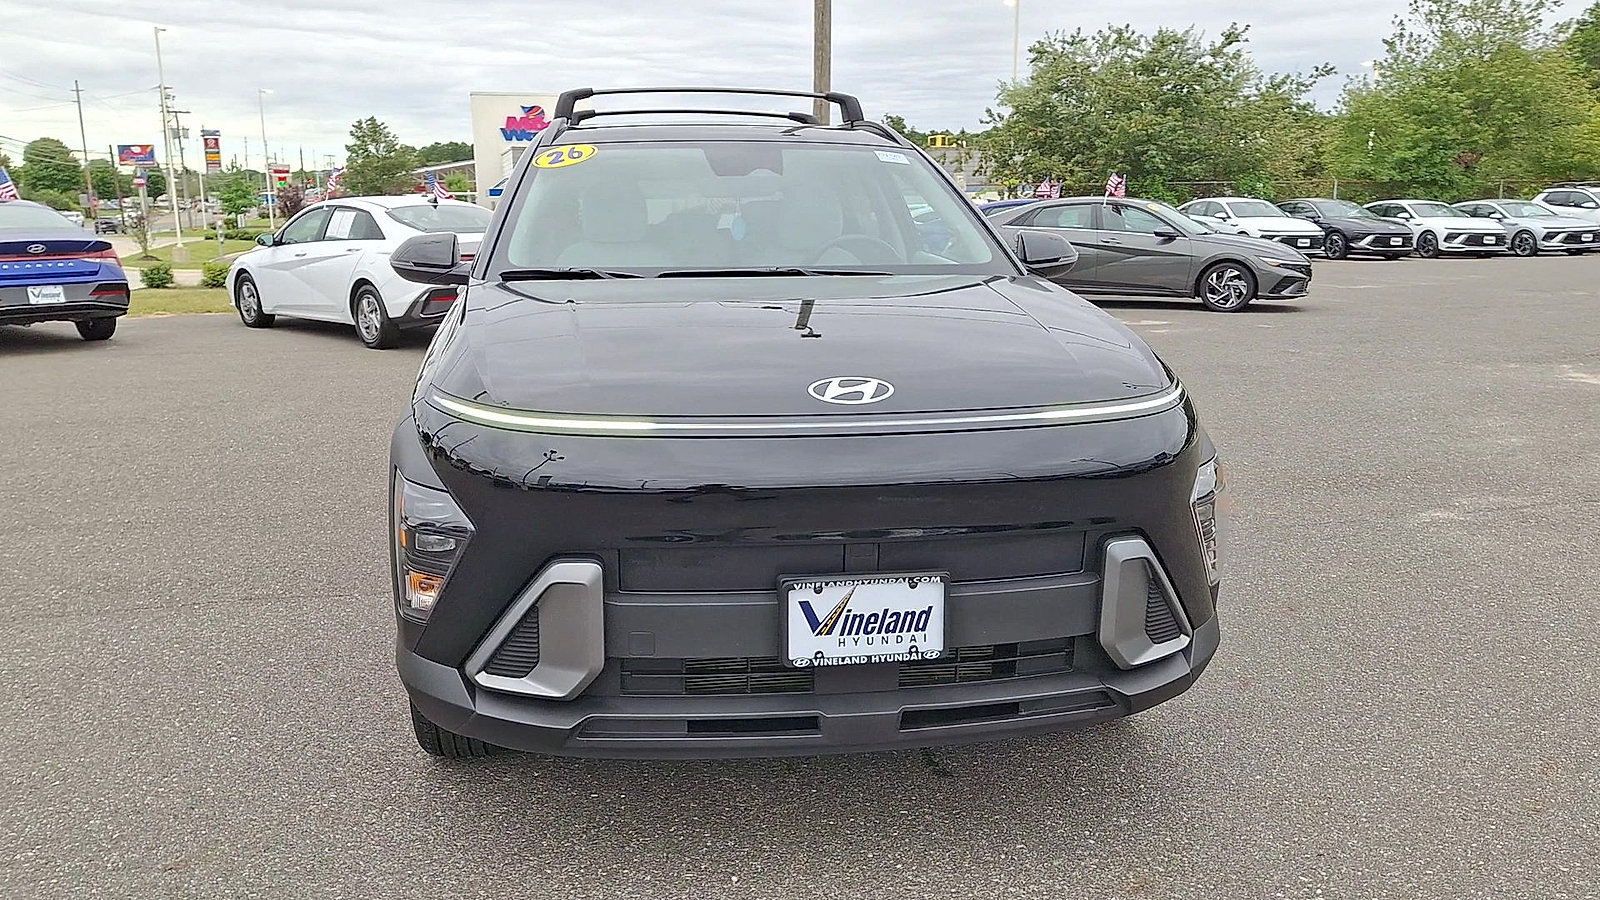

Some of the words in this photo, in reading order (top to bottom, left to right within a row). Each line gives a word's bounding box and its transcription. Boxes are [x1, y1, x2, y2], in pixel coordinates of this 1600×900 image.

[546, 147, 583, 165] 26
[793, 576, 941, 591] VINELANDHYUNDAI.COM
[798, 586, 933, 637] Vineland
[838, 633, 927, 647] HYUNDAI
[812, 655, 868, 667] VINELAND
[871, 652, 922, 664] HYUNDAI
